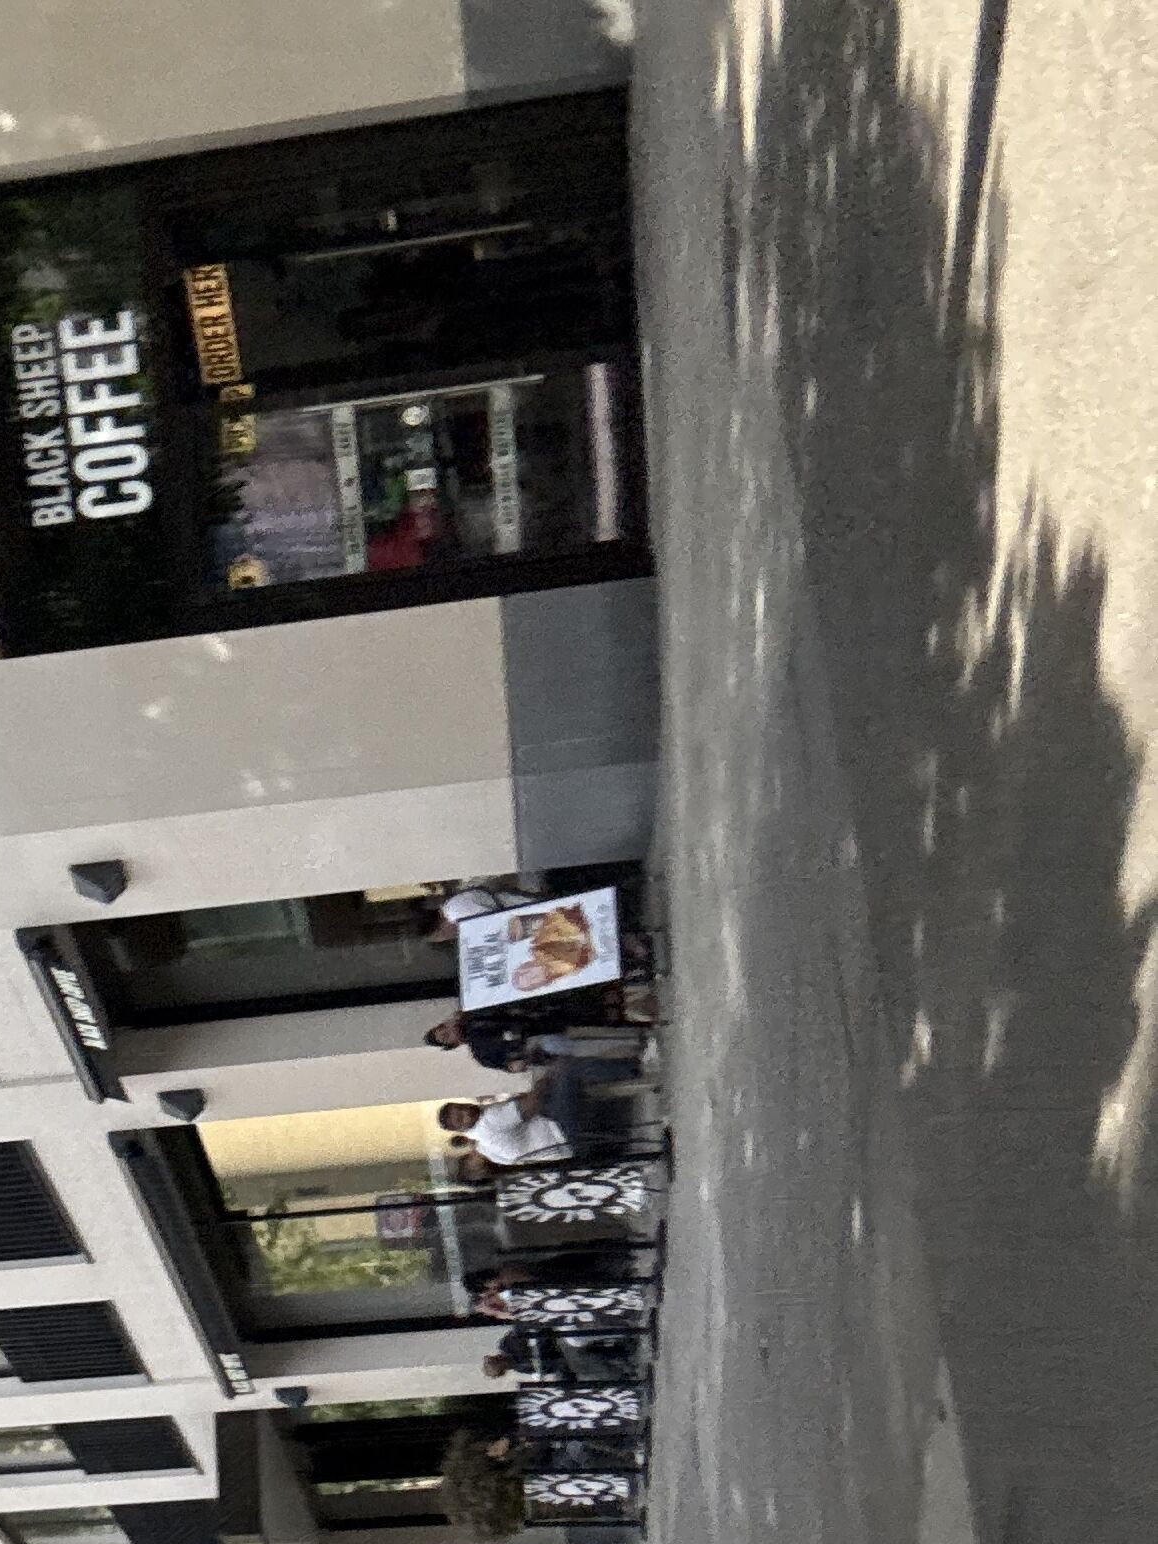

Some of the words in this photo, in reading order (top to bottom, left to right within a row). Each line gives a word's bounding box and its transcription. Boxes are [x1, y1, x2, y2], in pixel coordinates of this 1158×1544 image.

[10, 323, 62, 420] SHEEP
[197, 311, 237, 382] ORDER
[58, 309, 153, 519] COFFEE
[21, 425, 74, 528] BLACK
